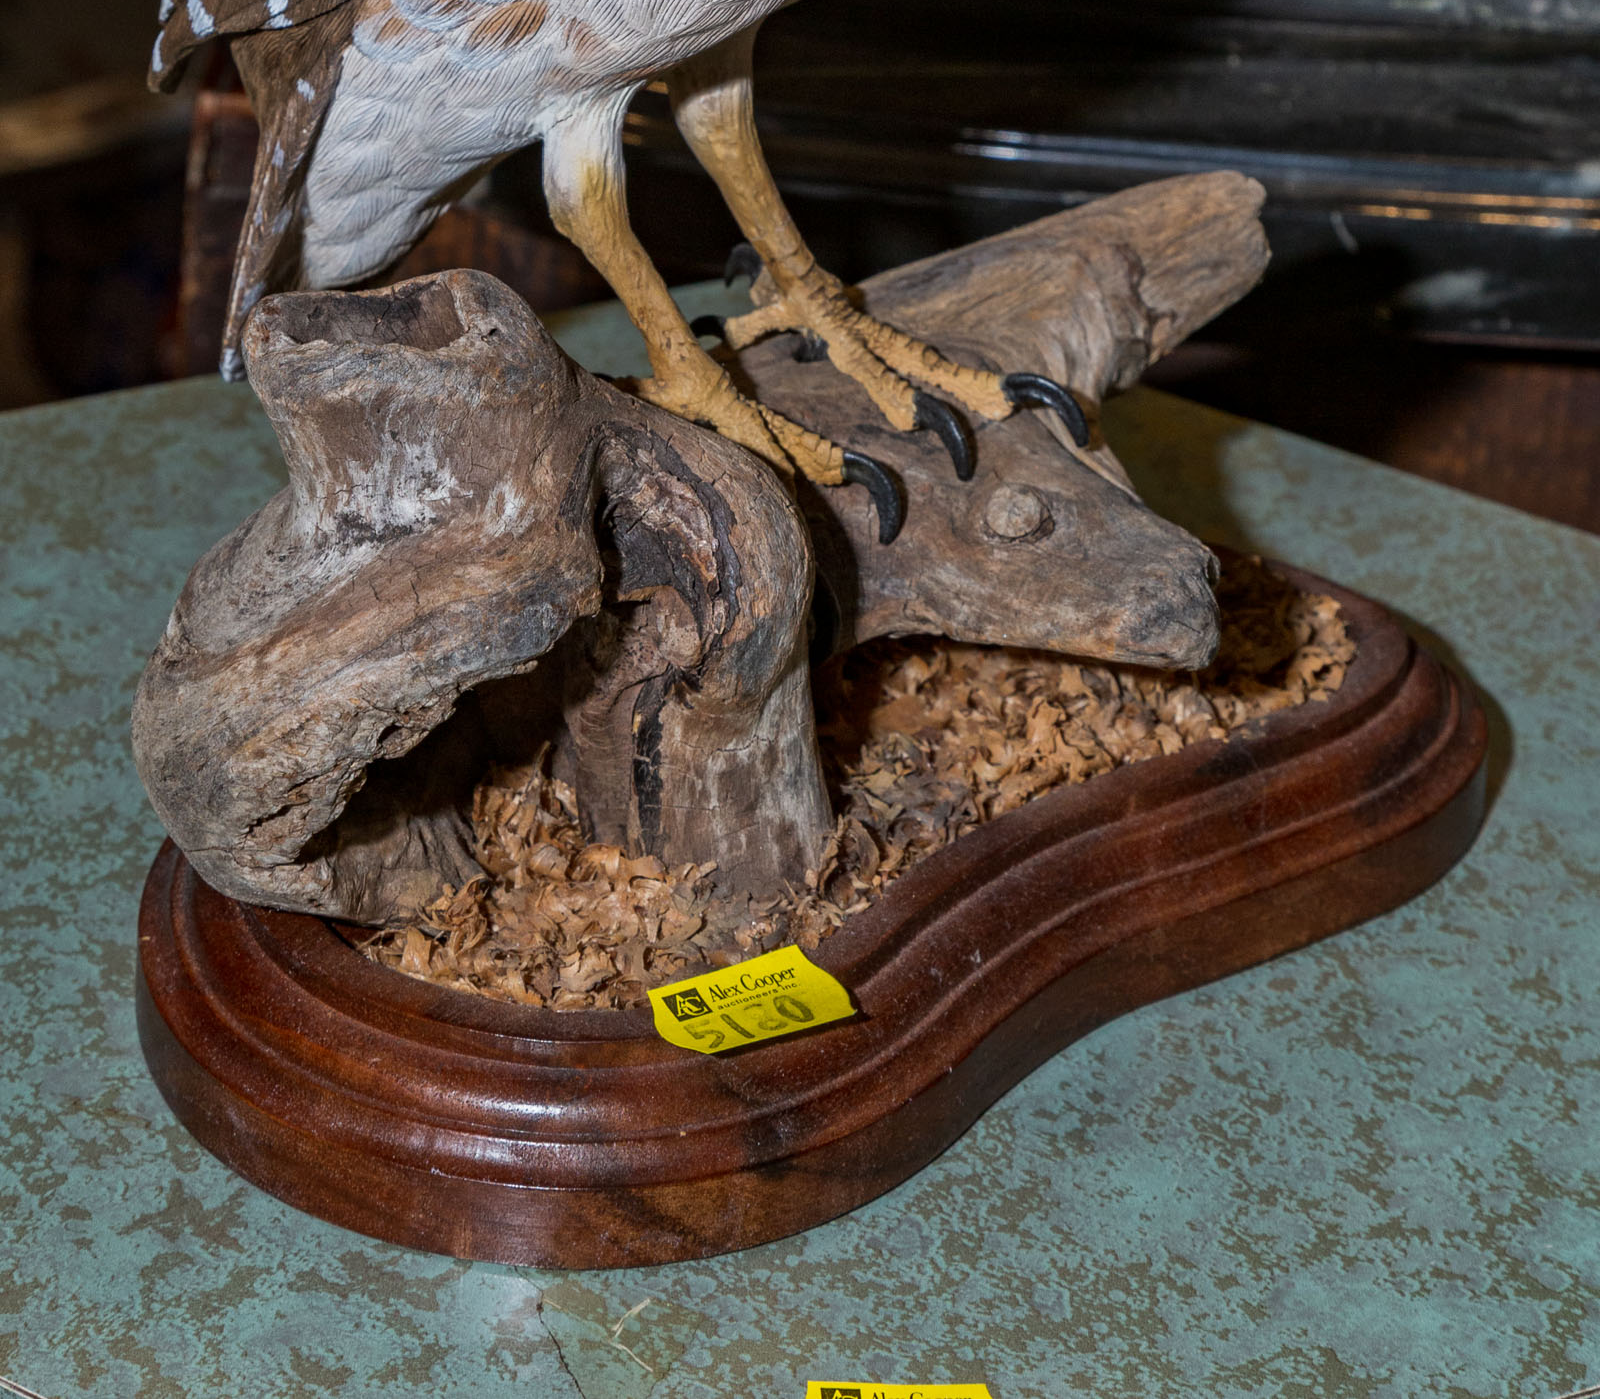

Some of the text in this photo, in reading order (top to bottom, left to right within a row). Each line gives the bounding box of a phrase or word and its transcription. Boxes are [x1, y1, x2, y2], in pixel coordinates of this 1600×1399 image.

[708, 967, 796, 1002] Alex Cooper
[718, 989, 779, 1010] auctioneers
